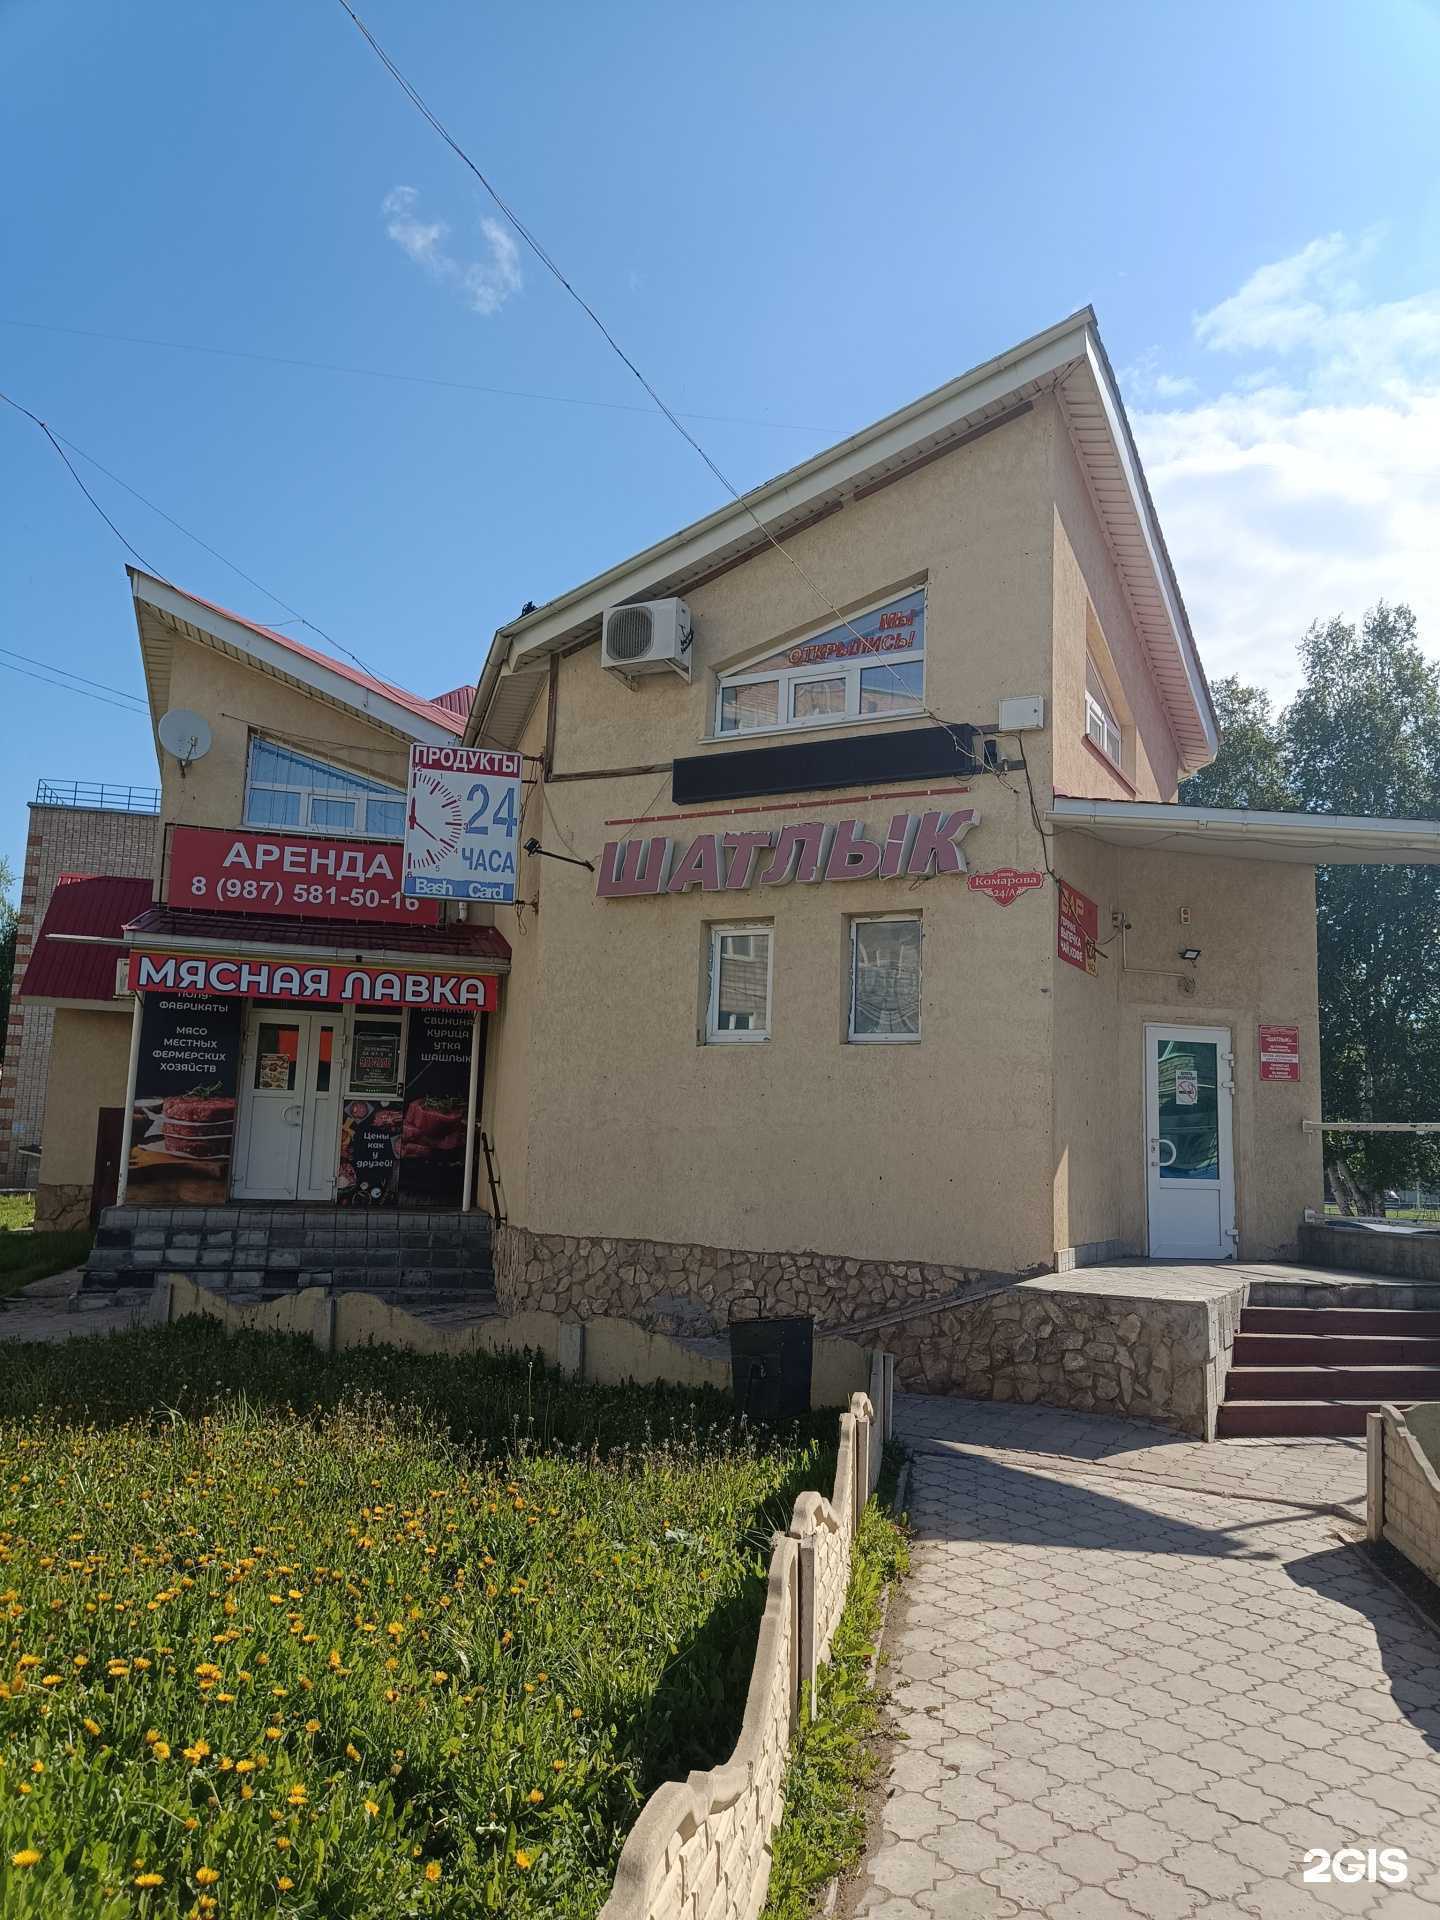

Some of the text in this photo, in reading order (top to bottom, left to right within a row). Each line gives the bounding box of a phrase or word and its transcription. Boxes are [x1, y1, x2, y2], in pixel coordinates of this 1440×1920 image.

[414, 746, 519, 773] ПРОДУКТЫ
[465, 783, 518, 837] 24
[596, 808, 979, 898] ШАТЛЫК
[222, 842, 394, 882] АРЕНДА
[461, 847, 515, 873] ЧАСА
[975, 877, 1037, 886] Комарова
[191, 876, 207, 896] 8
[216, 877, 284, 905] (987)
[415, 878, 504, 899] Bash Card
[138, 955, 485, 1006] МЯСНАЯ ЛАВКА
[159, 1001, 229, 1013] ФАБРИКАТЫ
[176, 1026, 208, 1036] МЯСО
[427, 1028, 469, 1039] КУРИЦА
[163, 1038, 218, 1049] МЕСТНЫХ
[433, 1041, 461, 1050] УТКА
[152, 1050, 226, 1061] ФЕРМЕРСКИХ
[160, 1062, 217, 1073] ХОЗЯЙСТВ
[363, 1131, 390, 1141] Цены
[372, 1151, 378, 1160] у
[356, 1160, 393, 1169] друзей!
